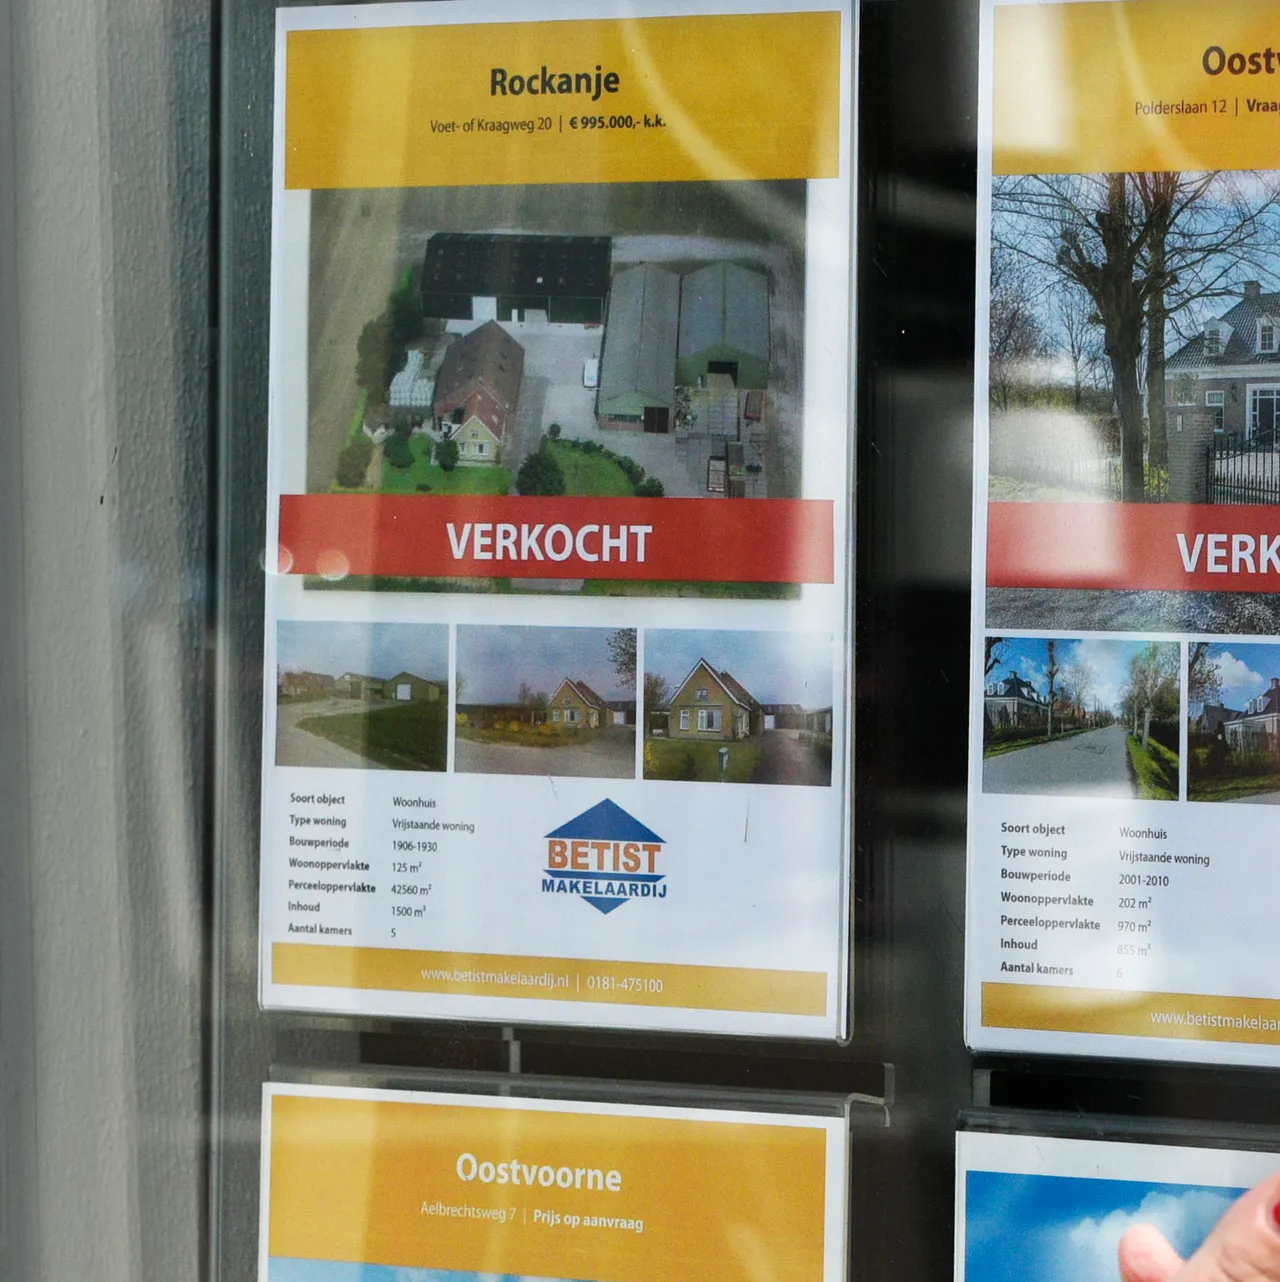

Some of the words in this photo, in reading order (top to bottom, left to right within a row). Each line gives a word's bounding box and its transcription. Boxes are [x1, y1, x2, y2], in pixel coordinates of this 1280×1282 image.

[491, 65, 620, 101] Rockanje
[1135, 100, 1208, 115] Polderslaan
[1212, 100, 1227, 113] 12
[430, 120, 460, 132] Voet-
[463, 118, 474, 131] of
[478, 118, 534, 134] Kraagweg
[538, 117, 552, 129] 20
[644, 114, 666, 127] k.k.
[446, 522, 652, 563] VERKOCHT
[290, 793, 314, 804] Soort
[317, 794, 345, 805] object
[393, 797, 436, 808] Woonhuis
[290, 815, 311, 826] Type
[314, 816, 346, 828] woning
[392, 819, 440, 830] Vrijstaande
[443, 822, 475, 833] woning
[1001, 822, 1030, 834] Soort
[1033, 824, 1065, 836] object
[1120, 827, 1167, 839] Woonhuis
[289, 836, 349, 848] Bouwperiode
[393, 841, 437, 852] 1906-1930
[548, 840, 661, 874] BETIST
[1001, 846, 1026, 858] Type
[1028, 848, 1067, 860] woning
[1120, 851, 1172, 863] Vrijstaande
[1175, 856, 1210, 867] woning
[289, 858, 369, 871] Woonoppervlakte
[393, 863, 407, 873] 125
[1001, 869, 1070, 882] Bouwperiode
[1119, 875, 1169, 886] 2001-2010
[289, 880, 376, 894] Perceeloppervlakte
[391, 884, 418, 895] 42560
[542, 879, 667, 898] MAKELAARDIJ
[288, 901, 320, 912] Inhoud
[392, 906, 412, 916] 1500
[1001, 892, 1094, 907] Woonoppervlakte
[1119, 898, 1135, 908] 202
[288, 923, 317, 934] Aantal
[320, 925, 352, 935] kamers
[391, 928, 396, 937] 5
[1001, 915, 1100, 930] Perceeloppervlakte
[1118, 921, 1135, 931] 970
[1001, 939, 1037, 950] Inhoud
[1001, 962, 1034, 973] Aantal
[1037, 963, 1073, 975] kamers
[421, 966, 569, 989] www.betistmakelaardij.nl
[587, 976, 663, 993] 0181-475100
[456, 1153, 621, 1191] Oostvoorne
[421, 1202, 506, 1223] Aelbrechtsweg
[509, 1208, 516, 1220] 7
[534, 1209, 560, 1227] Prijs
[564, 1214, 580, 1228] op
[583, 1216, 643, 1233] aanvraag
